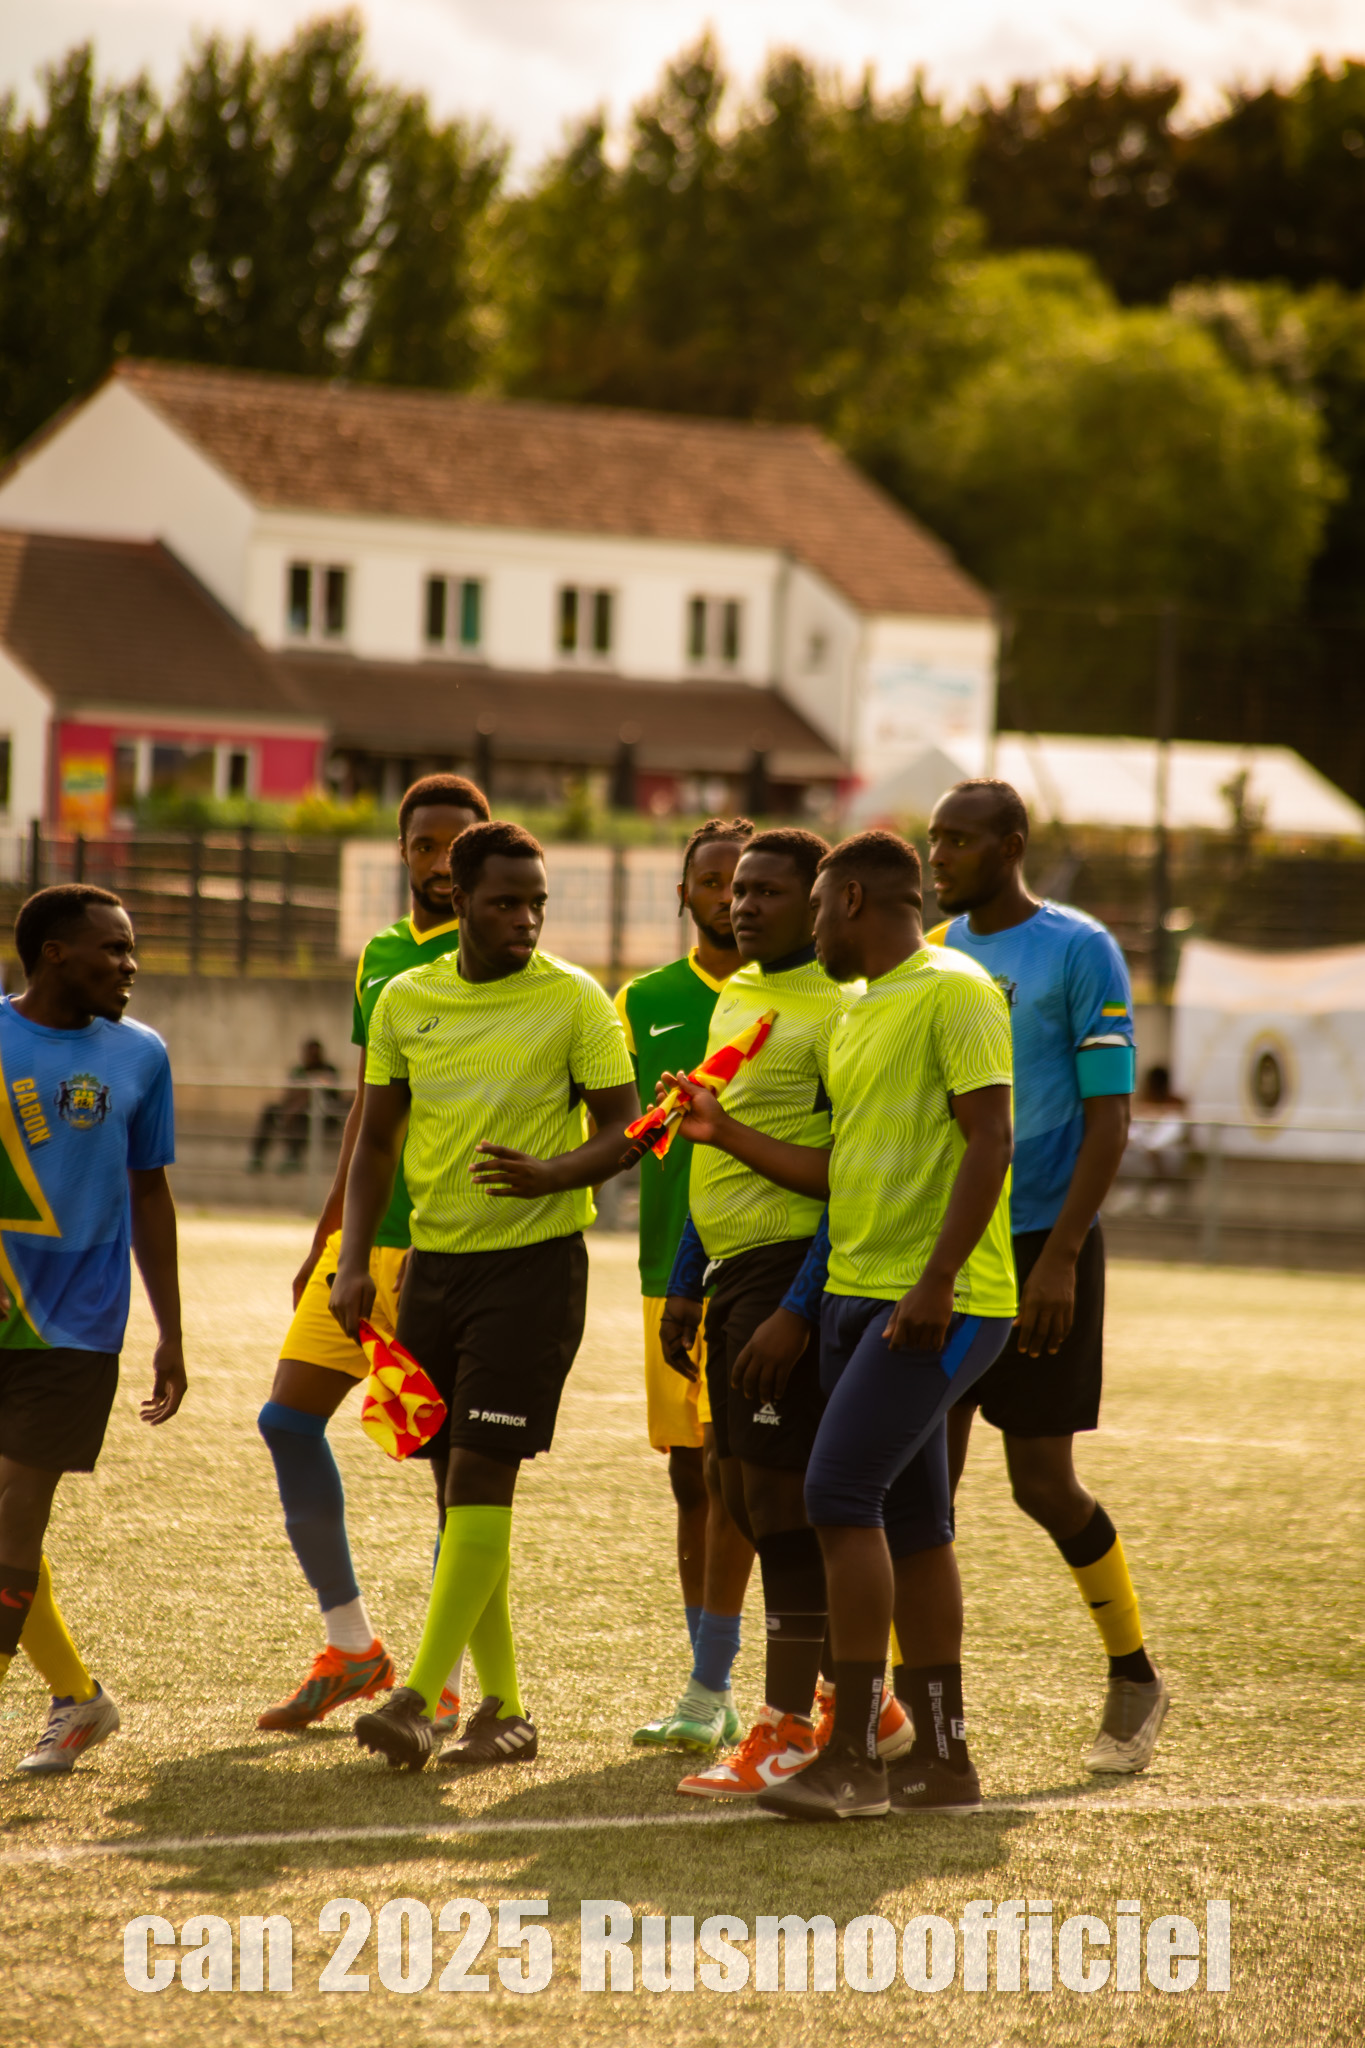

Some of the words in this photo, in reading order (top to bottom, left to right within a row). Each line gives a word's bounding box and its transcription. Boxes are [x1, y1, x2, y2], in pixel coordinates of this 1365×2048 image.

[12, 1078, 51, 1145] GABON
[481, 1411, 527, 1427] PATRICK
[753, 1413, 781, 1426] PEAK
